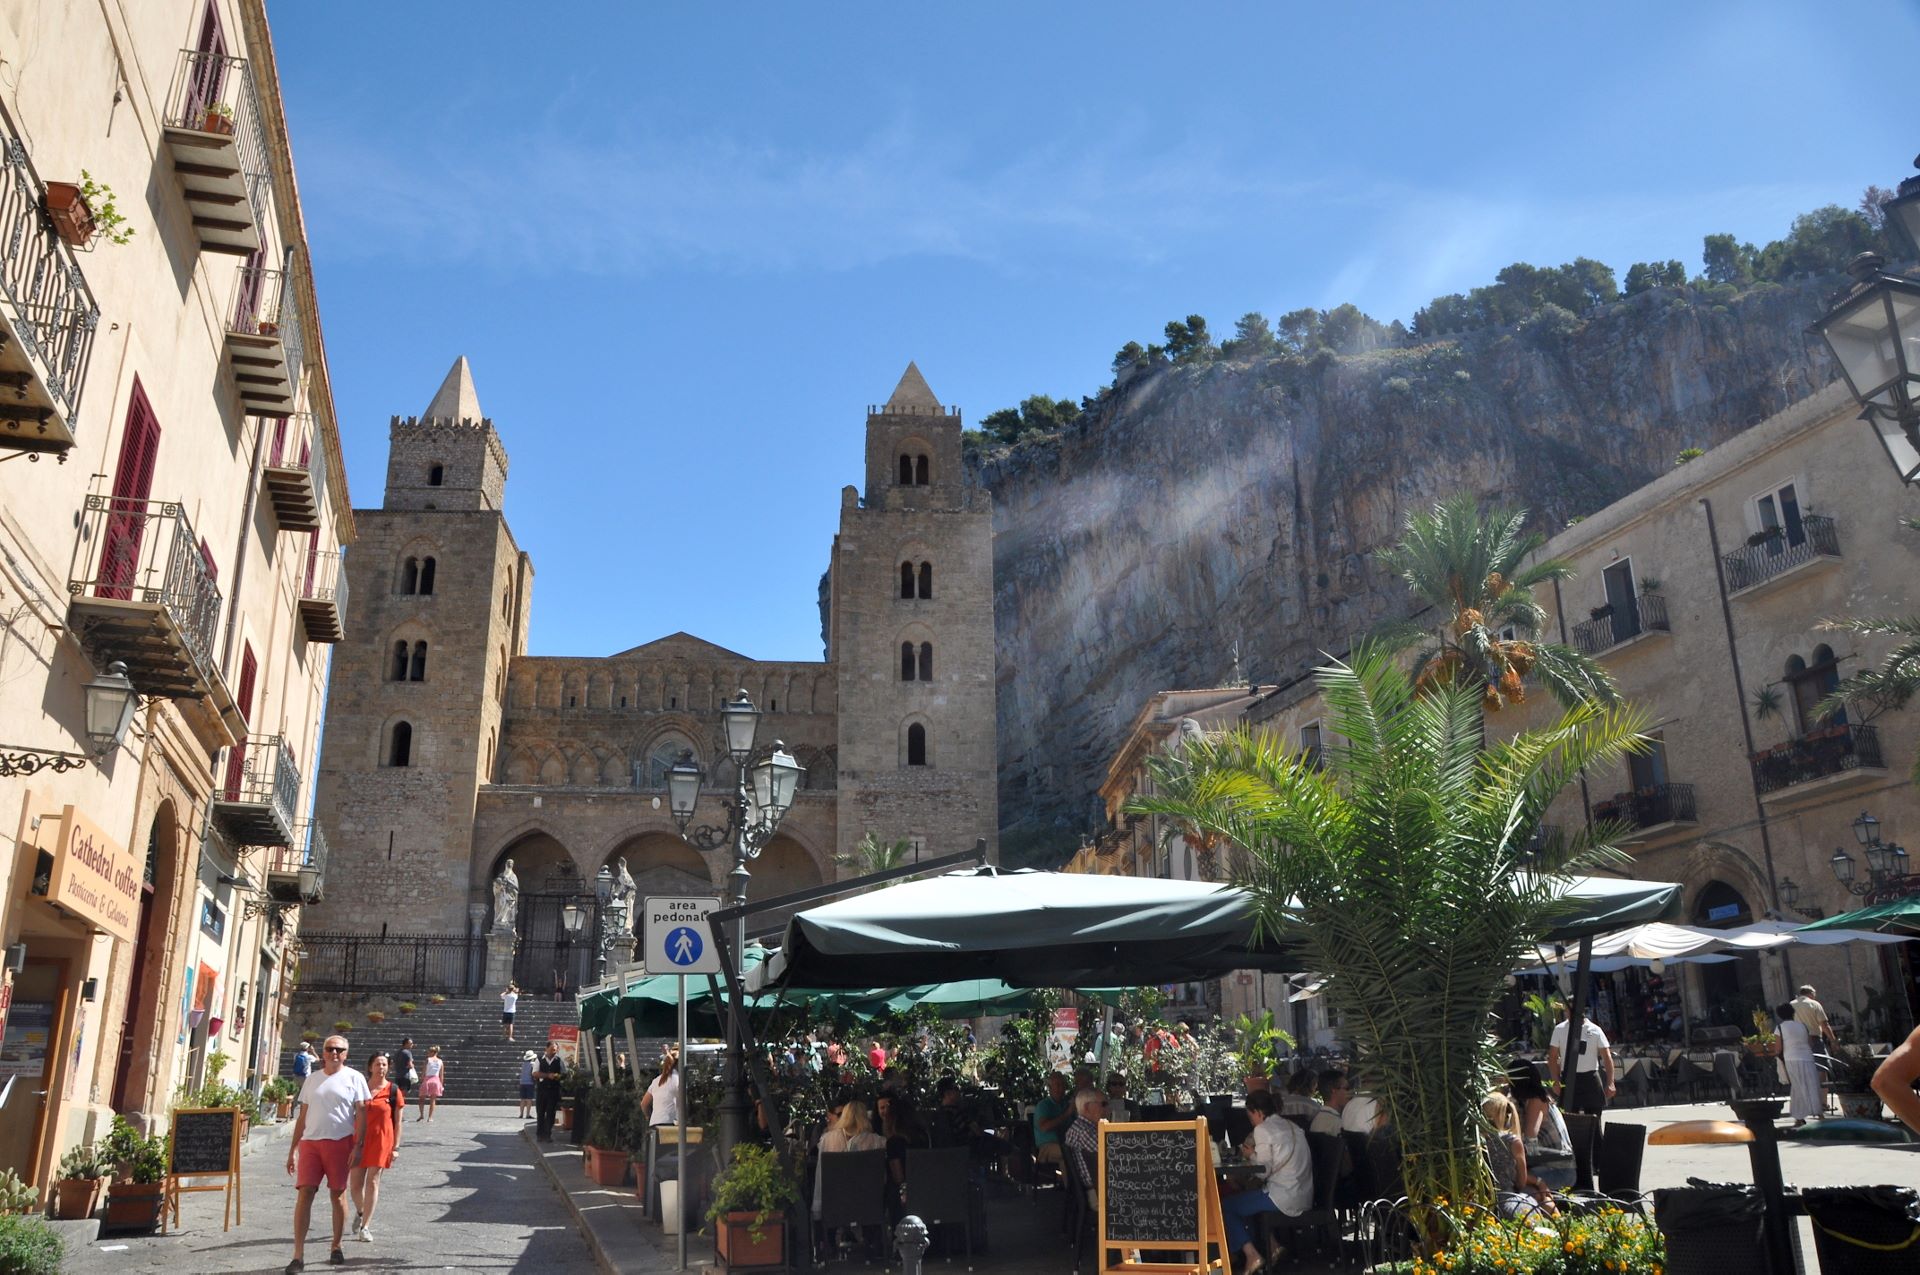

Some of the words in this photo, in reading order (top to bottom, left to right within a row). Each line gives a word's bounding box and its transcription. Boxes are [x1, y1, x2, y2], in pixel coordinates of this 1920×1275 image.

[70, 824, 115, 883] Cathedral
[114, 865, 138, 901] coffee
[98, 894, 106, 914] &
[669, 902, 696, 910] area
[653, 911, 709, 924] pedonal
